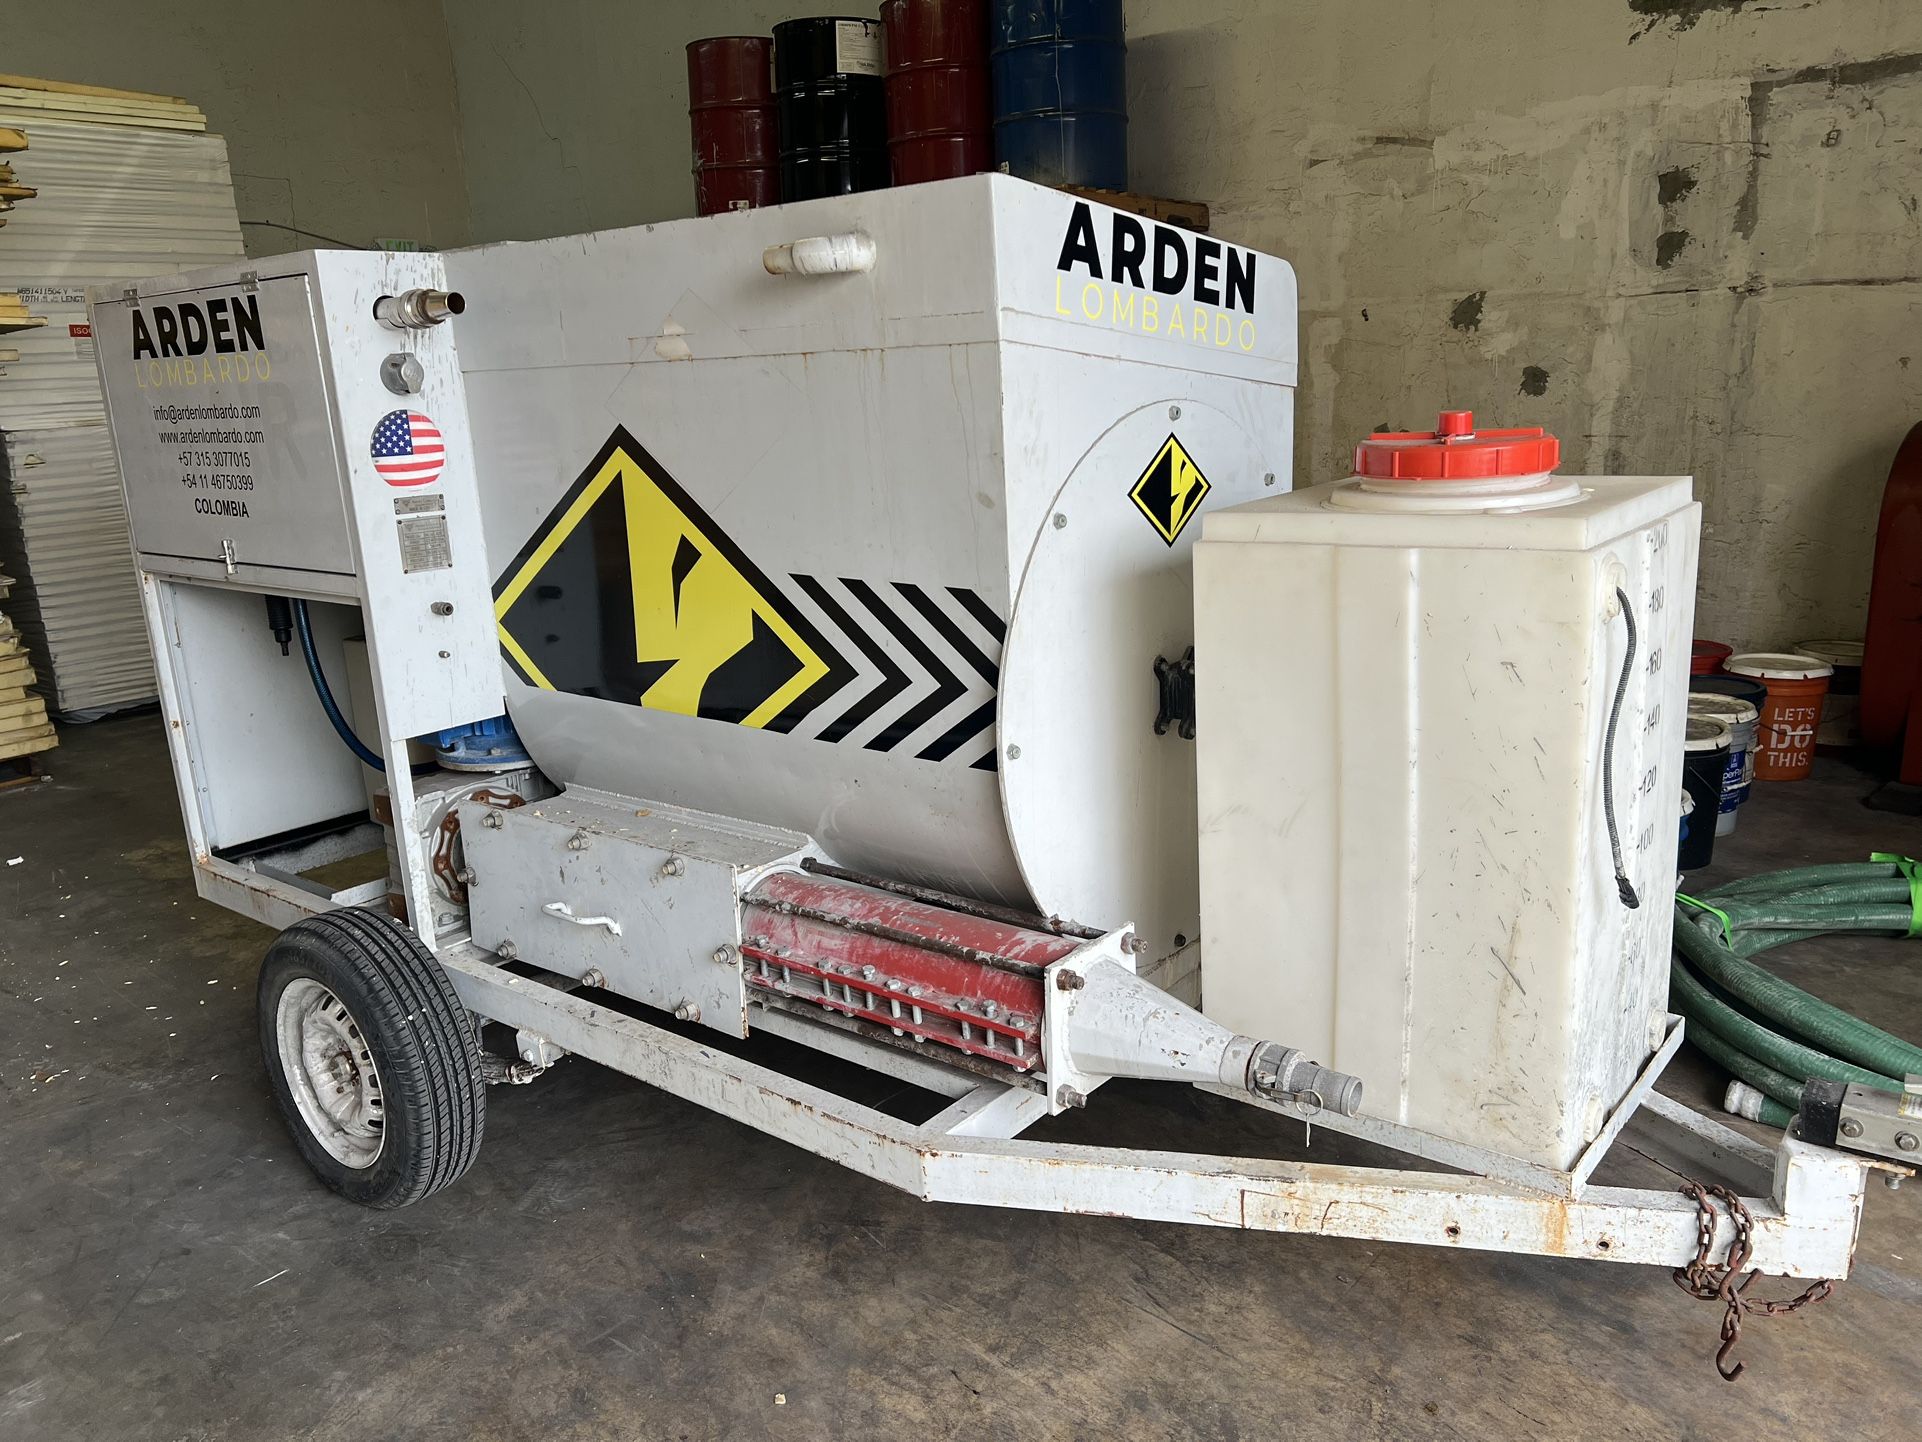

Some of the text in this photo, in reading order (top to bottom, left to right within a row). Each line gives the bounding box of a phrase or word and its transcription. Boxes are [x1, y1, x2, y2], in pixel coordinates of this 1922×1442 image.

[1057, 201, 1257, 315] ARDEN
[1055, 273, 1256, 351] LOMBARDO
[73, 327, 91, 335] ISO
[132, 294, 265, 360] ARDEN
[133, 352, 271, 388] LOMBARDO
[153, 403, 261, 424] info@ardenlombardo.com
[159, 427, 265, 443] www.ardenlombardo.com
[178, 451, 251, 468] +57 315 3077015
[181, 473, 254, 491] +54 11 46750399
[194, 497, 250, 518] COLOMBIA
[1774, 707, 1816, 721] LET'S
[1770, 723, 1813, 749] DO
